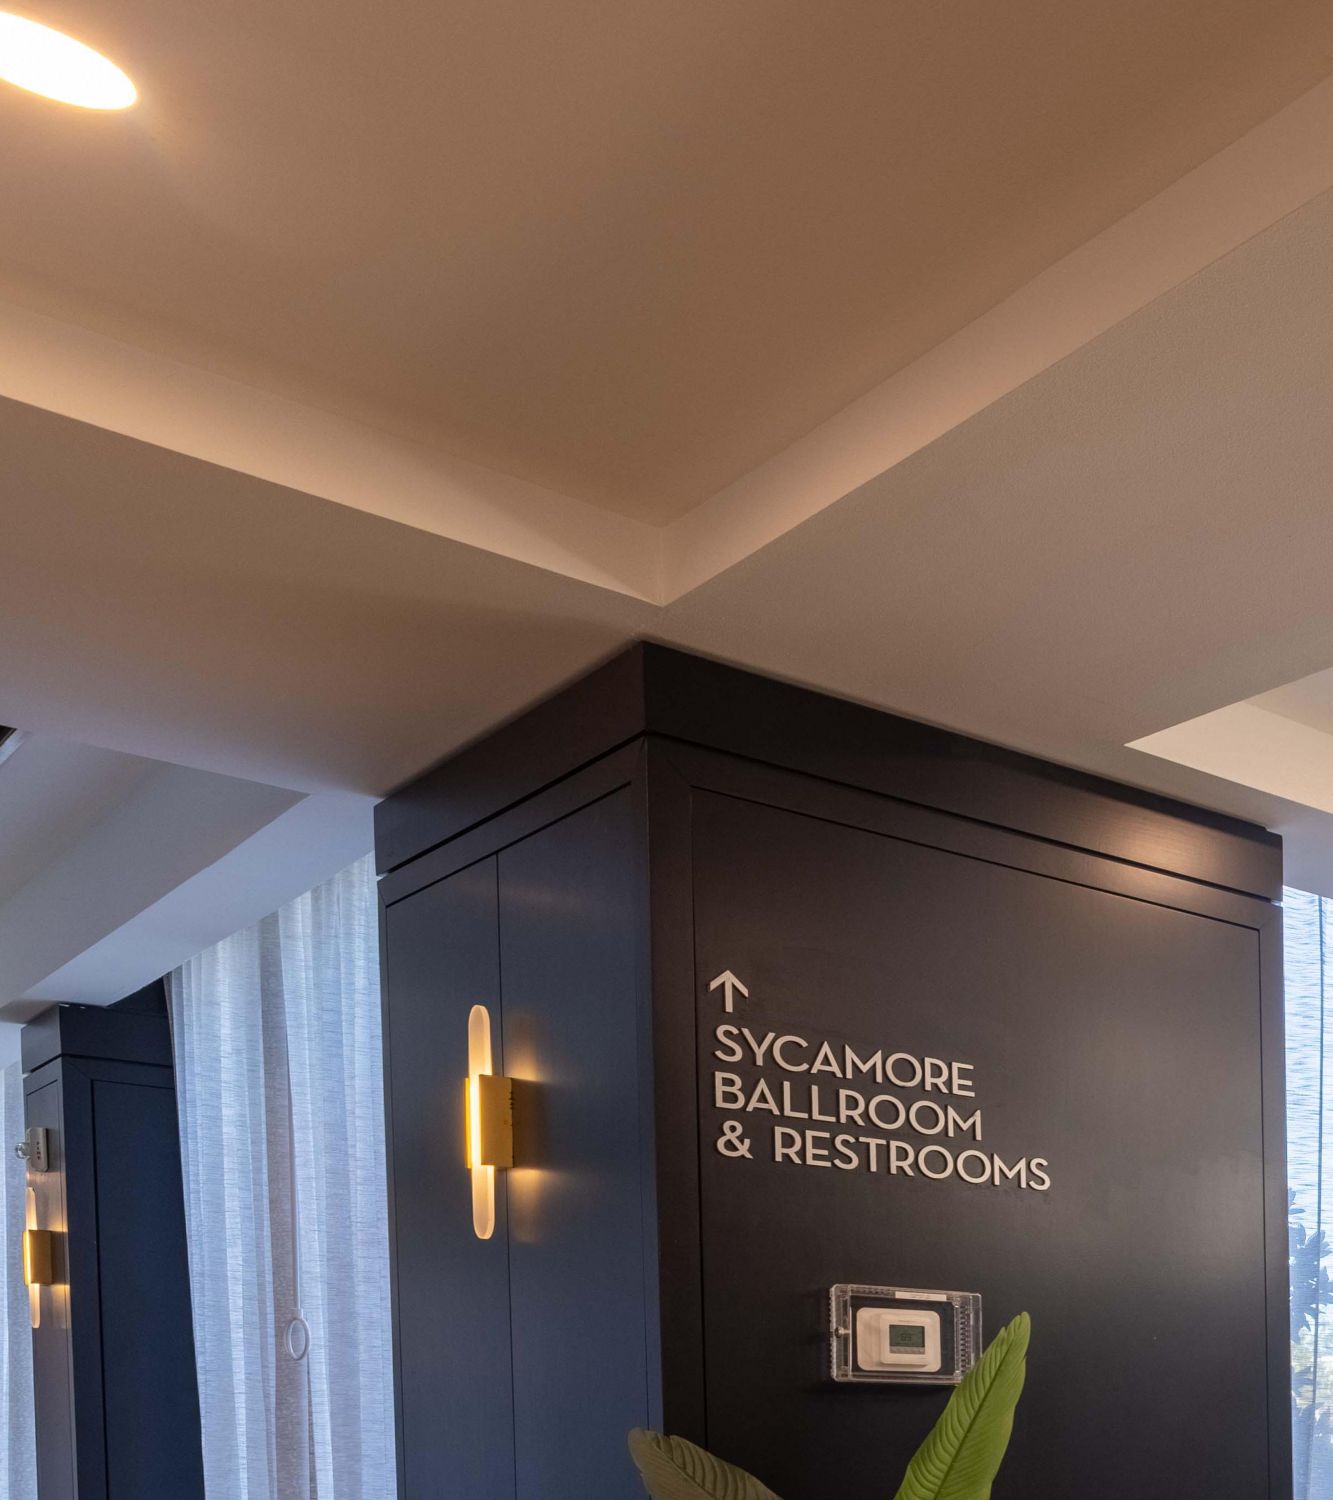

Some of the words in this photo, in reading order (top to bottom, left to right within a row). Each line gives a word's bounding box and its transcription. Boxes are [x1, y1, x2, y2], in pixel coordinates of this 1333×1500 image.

[714, 1024, 976, 1098] SYCAMORE
[714, 1071, 983, 1141] BALLROOM
[717, 1120, 753, 1159] &
[774, 1126, 1052, 1191] RESTROOMS
